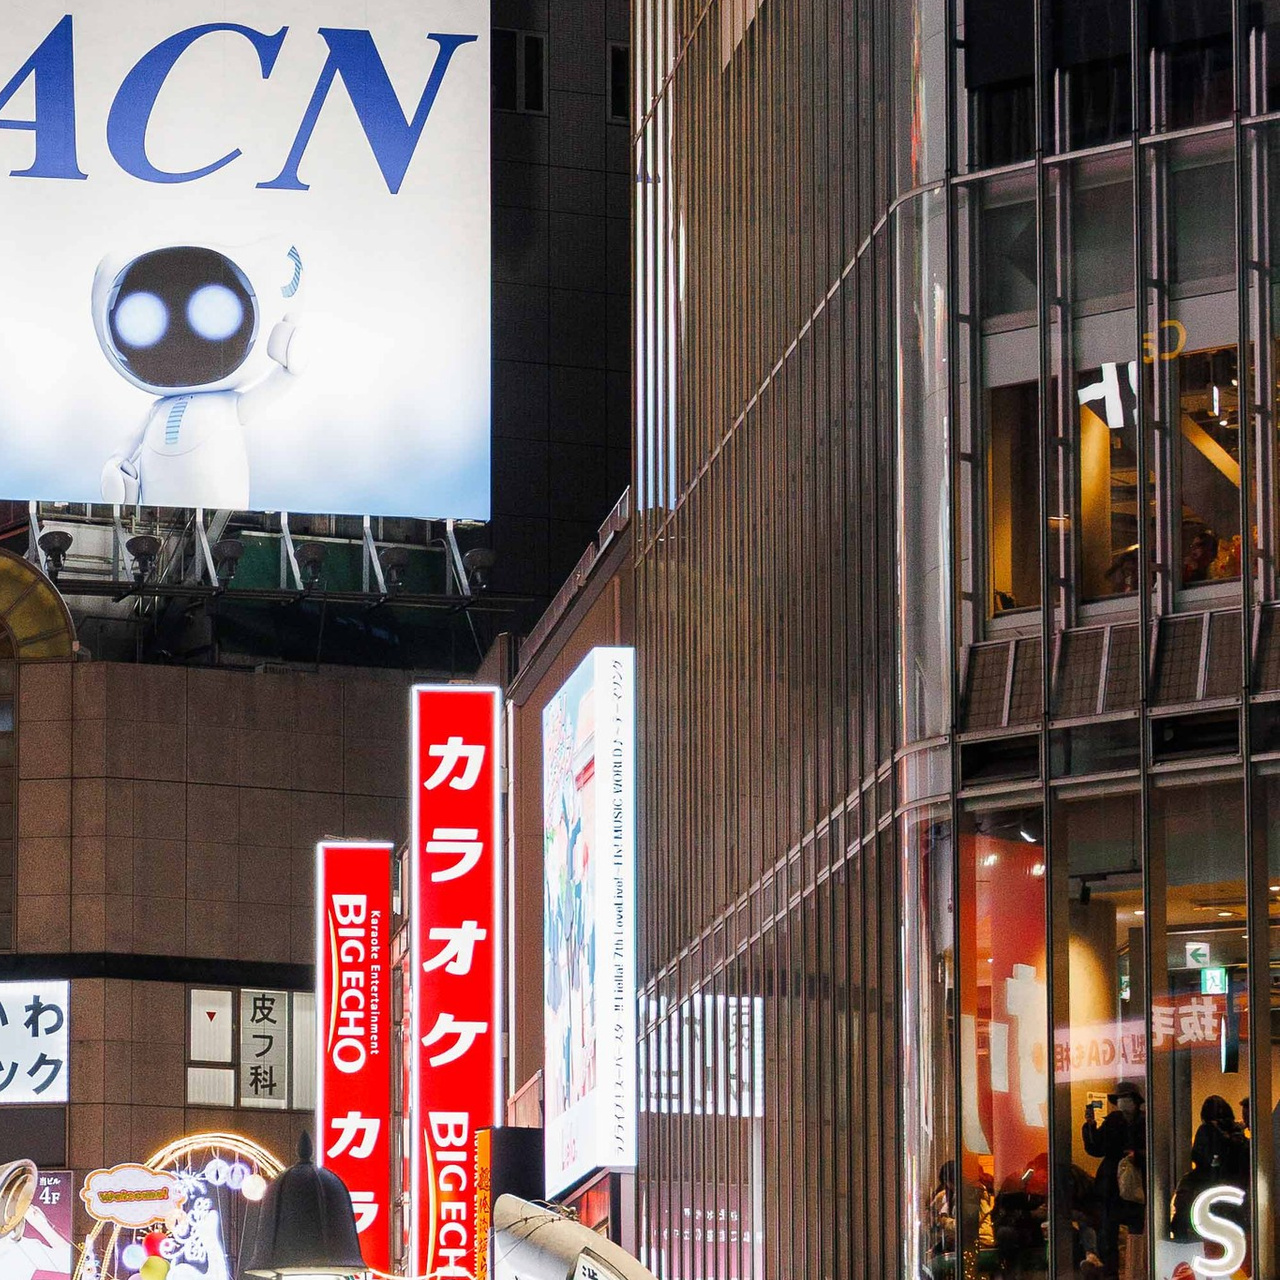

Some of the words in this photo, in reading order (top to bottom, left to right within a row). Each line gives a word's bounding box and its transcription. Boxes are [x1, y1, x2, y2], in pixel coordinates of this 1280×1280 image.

[331, 894, 367, 963] BIG
[370, 910, 381, 959] Karaoke
[423, 736, 488, 1068] カラオケ
[249, 993, 277, 1096] 皮フ科
[332, 971, 367, 1073] ECHO
[370, 965, 381, 1056] Entertainment
[39, 1186, 61, 1205] 4F
[428, 1111, 469, 1192] BIG
[1190, 1184, 1247, 1277] S
